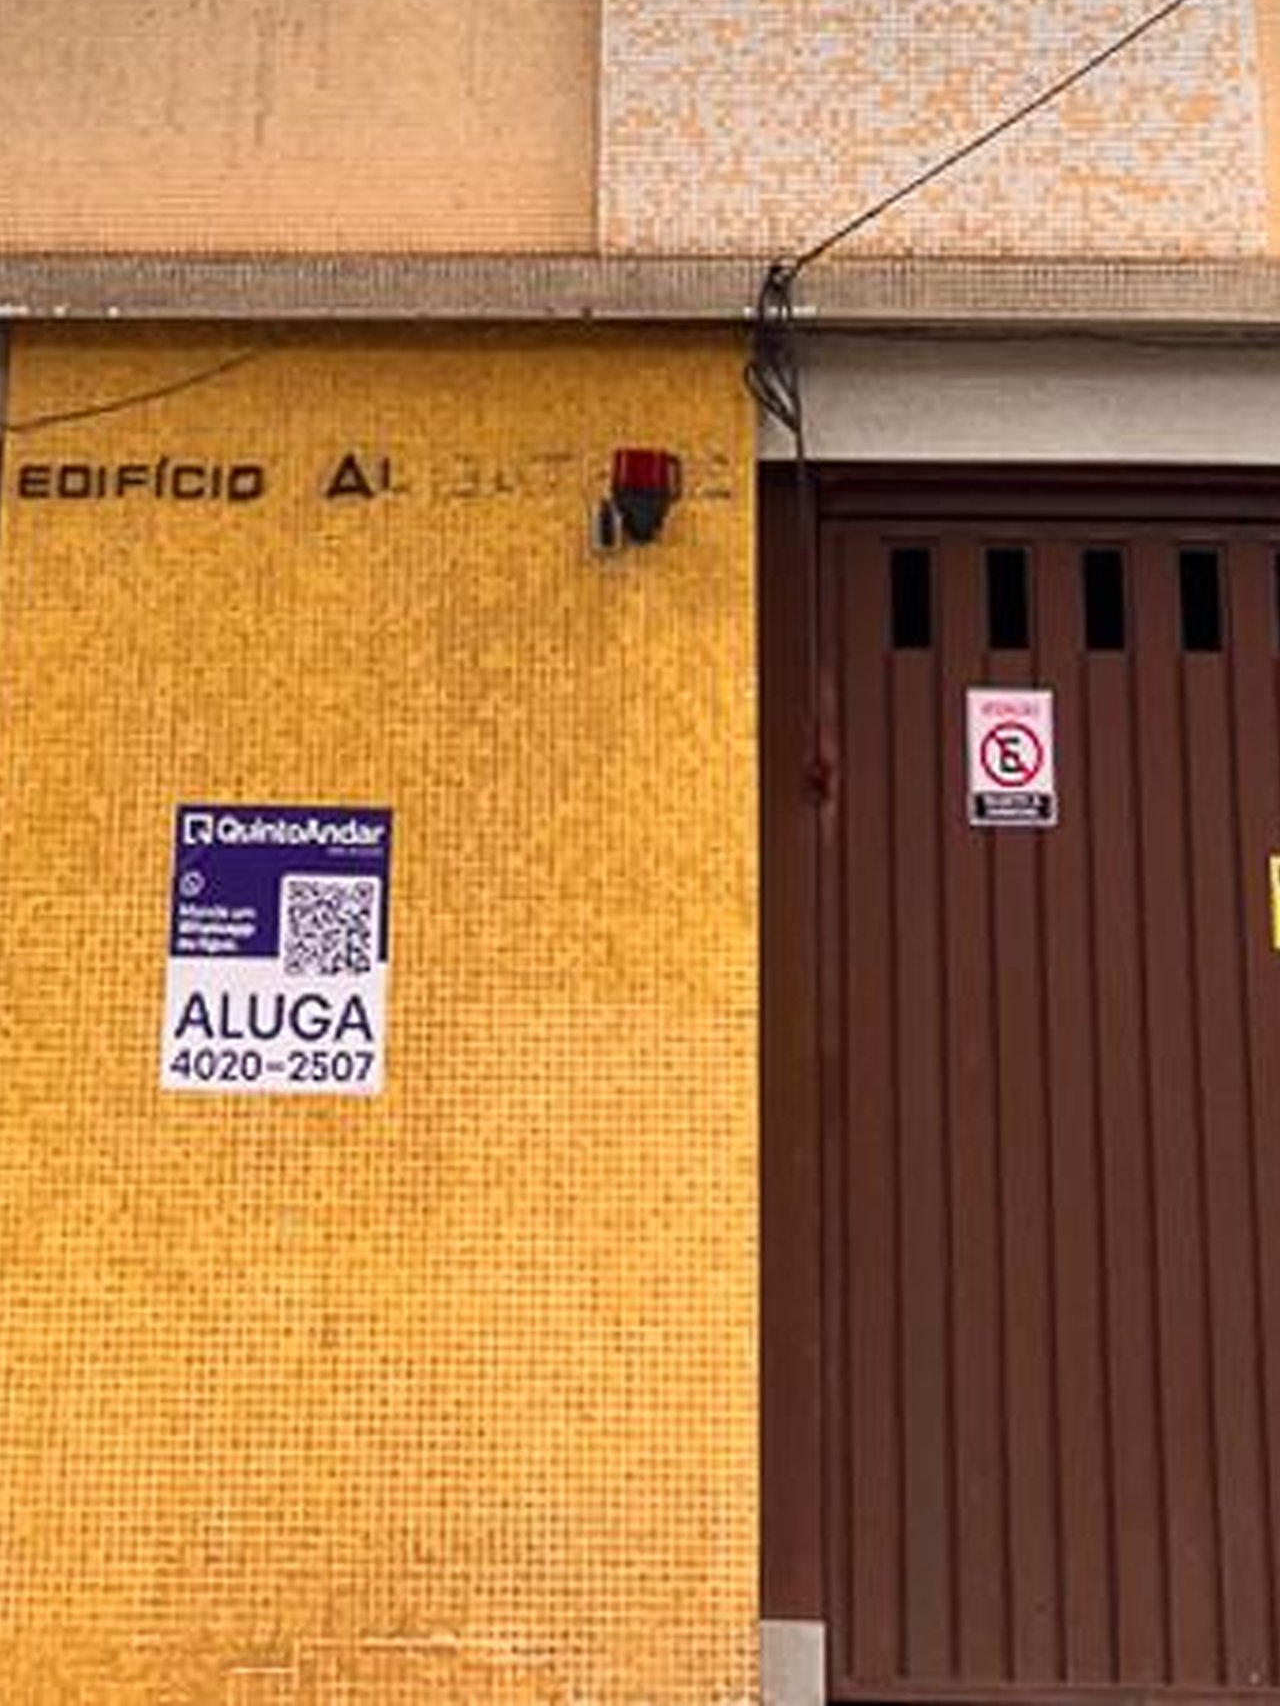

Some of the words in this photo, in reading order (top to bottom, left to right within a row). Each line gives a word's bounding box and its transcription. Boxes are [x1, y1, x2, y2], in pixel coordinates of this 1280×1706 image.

[18, 456, 264, 501] EDIFÍCIO
[217, 816, 385, 845] QuintoAndar
[174, 990, 374, 1042] ALUGA
[169, 1048, 375, 1082] 4020-2507
